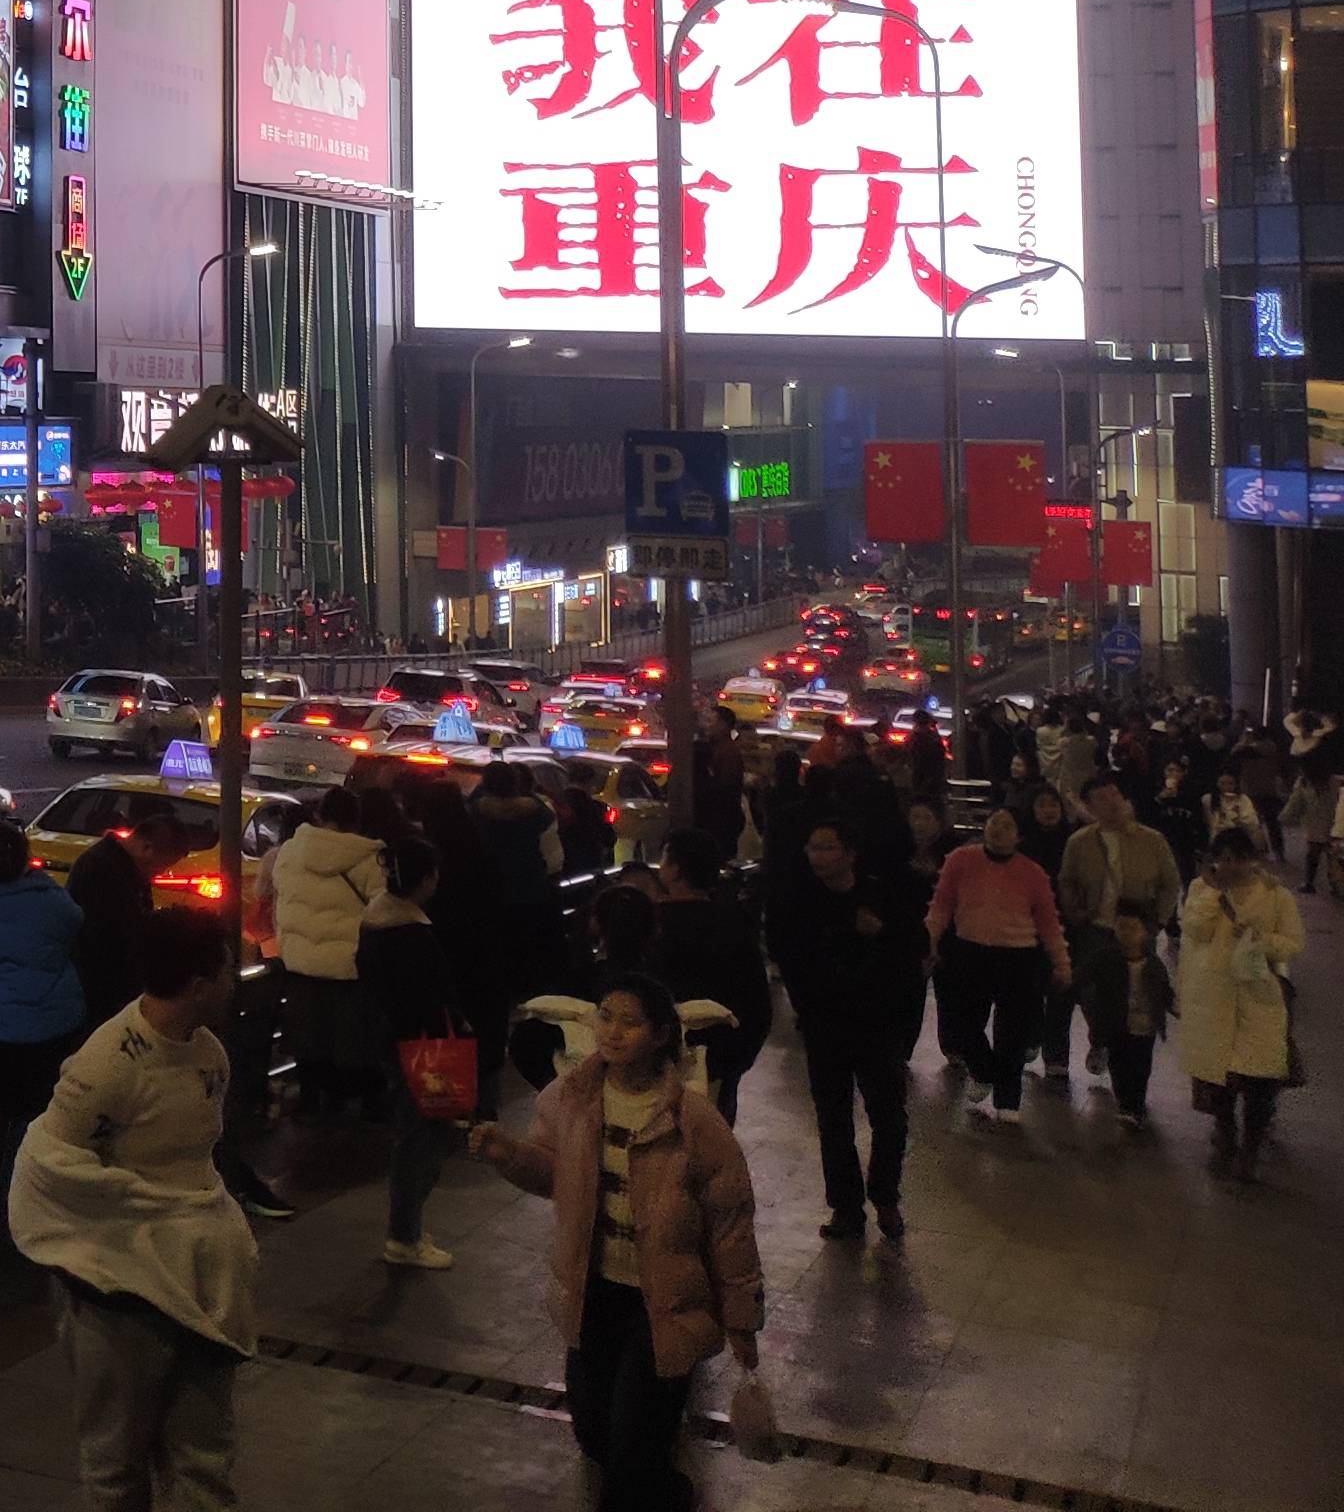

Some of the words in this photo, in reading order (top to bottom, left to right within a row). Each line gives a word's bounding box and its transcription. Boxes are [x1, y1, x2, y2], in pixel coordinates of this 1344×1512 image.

[71, 188, 84, 249] 商场
[497, 147, 991, 315] 重庆
[69, 257, 84, 278] 2F
[126, 357, 184, 381] 从这里到2楼
[636, 445, 685, 518] P
[634, 547, 723, 573] 即停即走
